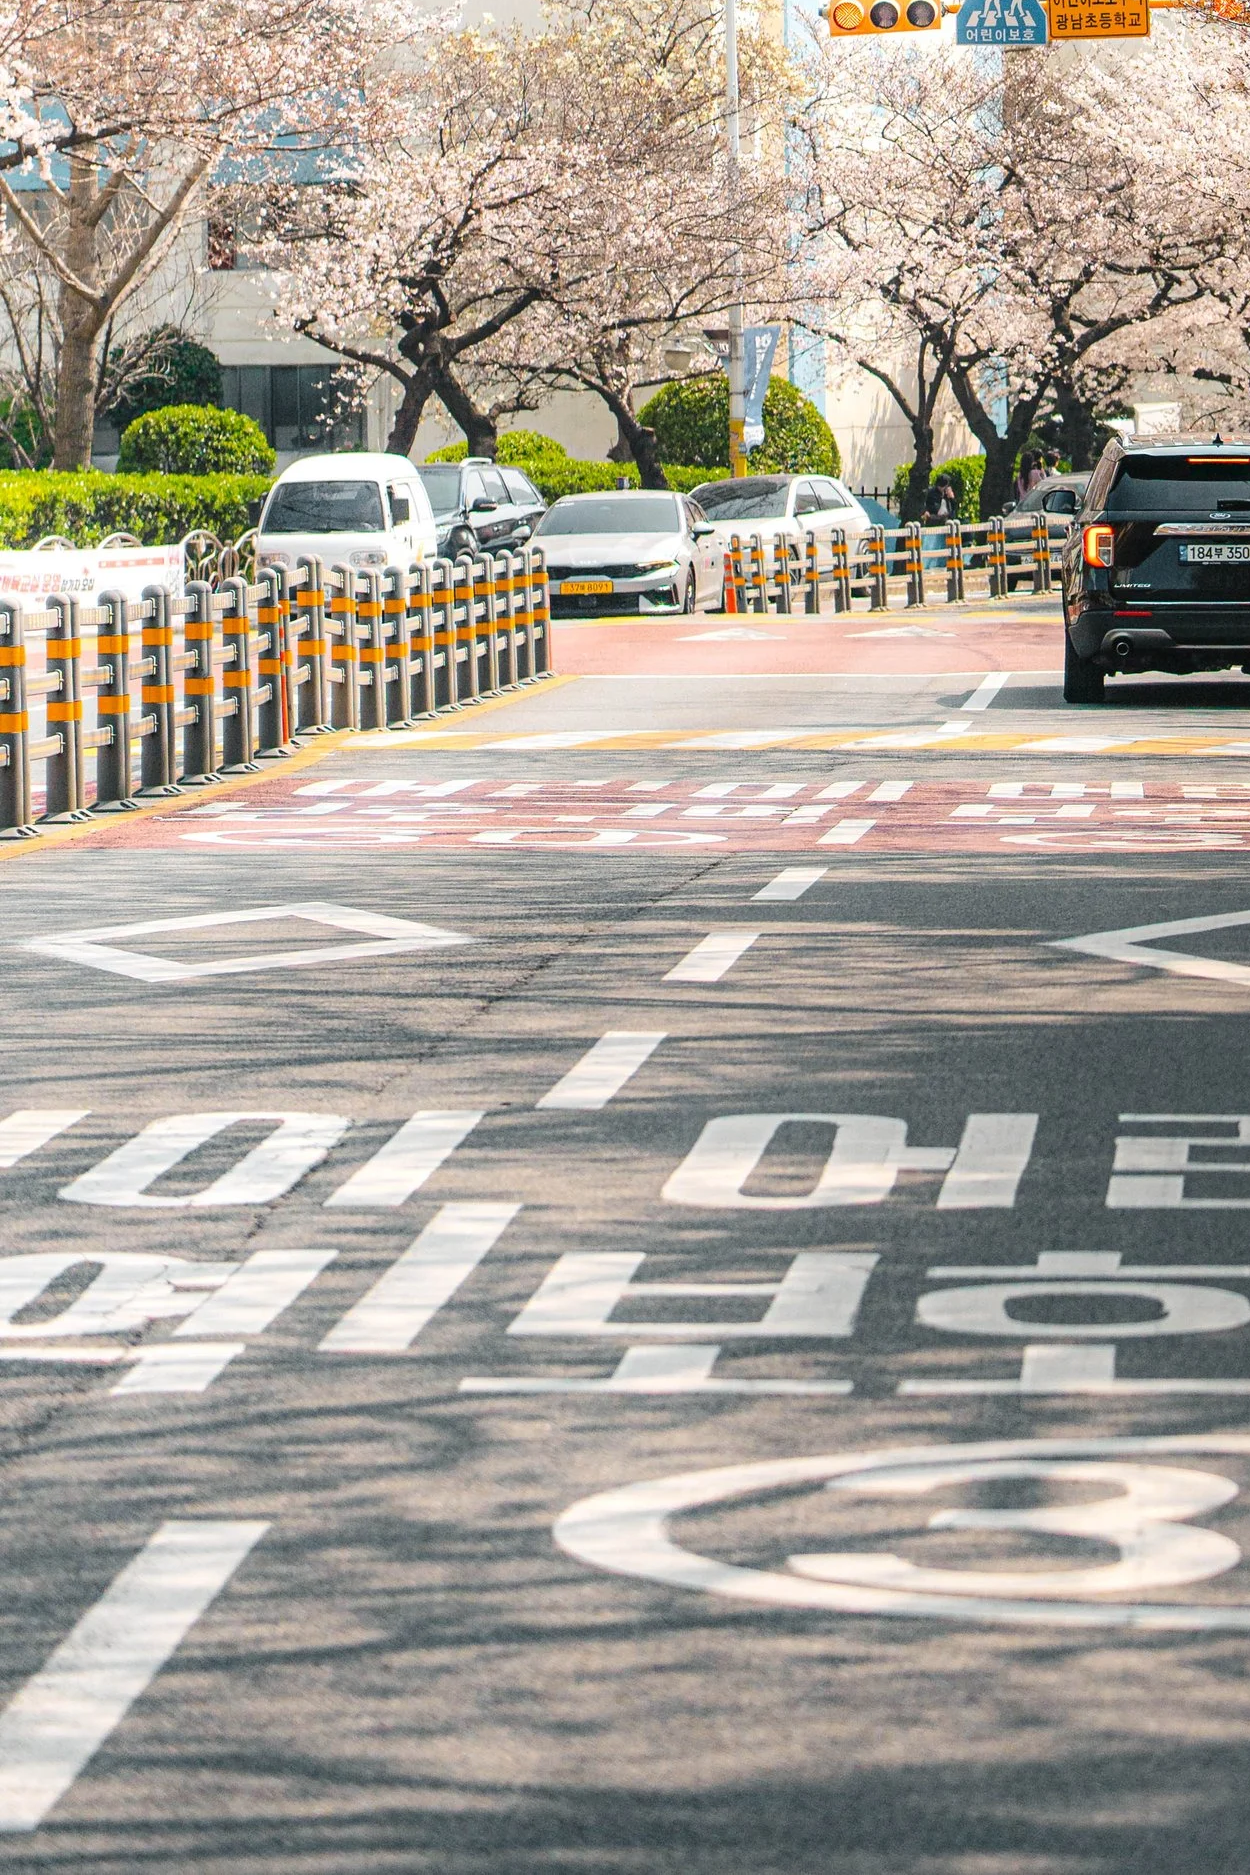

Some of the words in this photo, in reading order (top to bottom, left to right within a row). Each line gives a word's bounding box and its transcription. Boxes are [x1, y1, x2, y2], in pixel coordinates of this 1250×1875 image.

[1056, 10, 1141, 33] 광남초등학교
[966, 27, 1036, 43] 어린이보호
[1190, 546, 1223, 560] 184부
[291, 779, 865, 799] 어린이
[152, 802, 838, 825] 보호구역
